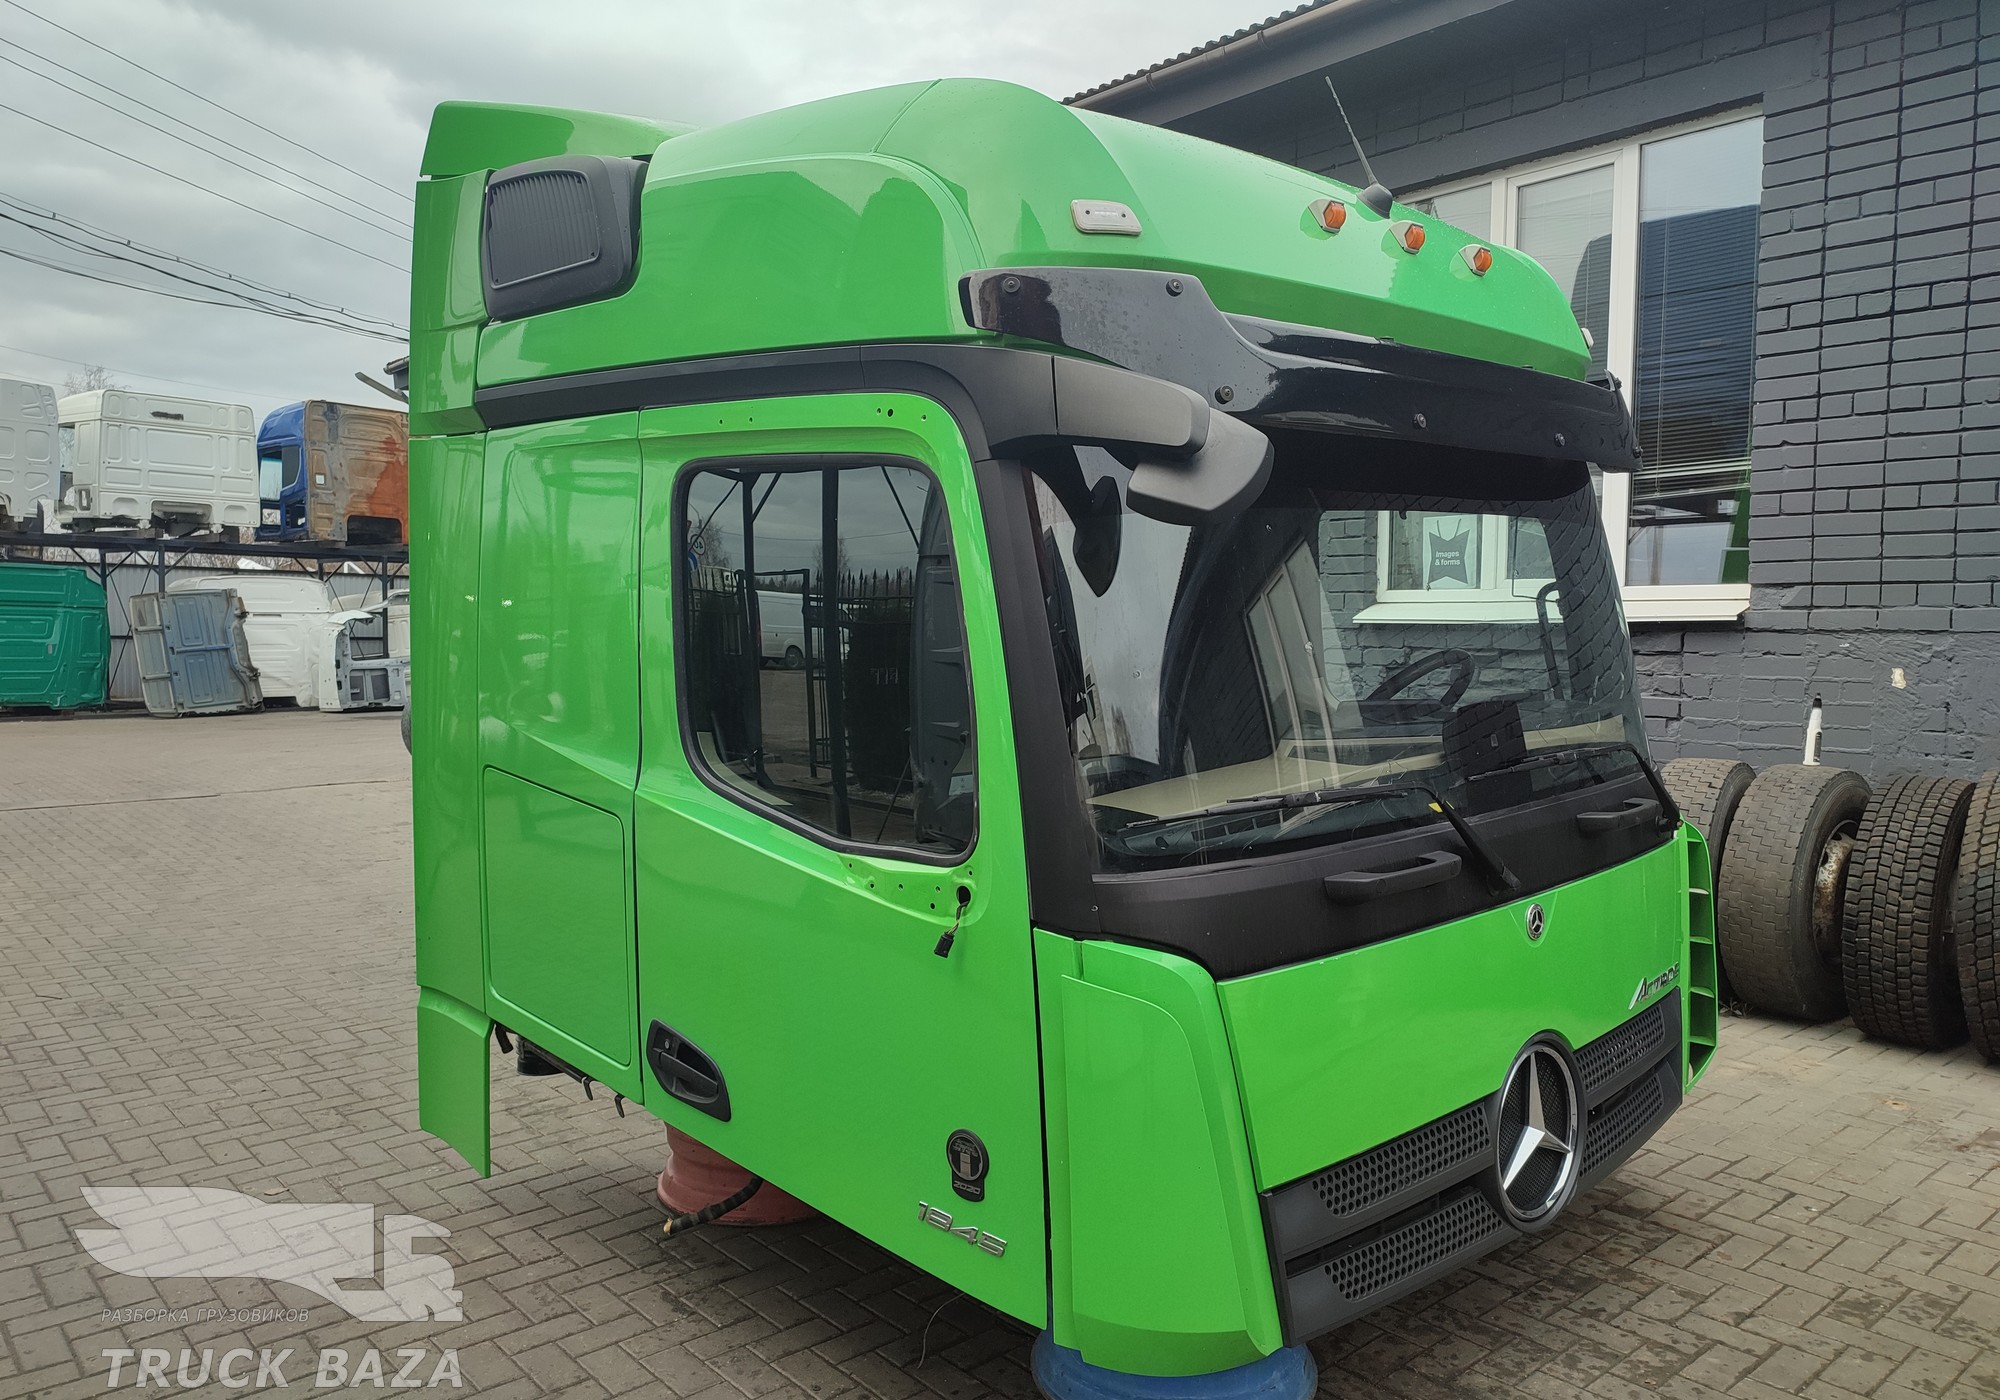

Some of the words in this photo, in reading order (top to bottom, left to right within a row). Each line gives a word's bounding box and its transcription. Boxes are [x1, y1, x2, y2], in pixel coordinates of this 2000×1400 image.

[1435, 551, 1460, 559] Images
[1441, 558, 1461, 566] forms
[953, 1180, 981, 1195] 2020
[918, 1200, 1008, 1257] 1845
